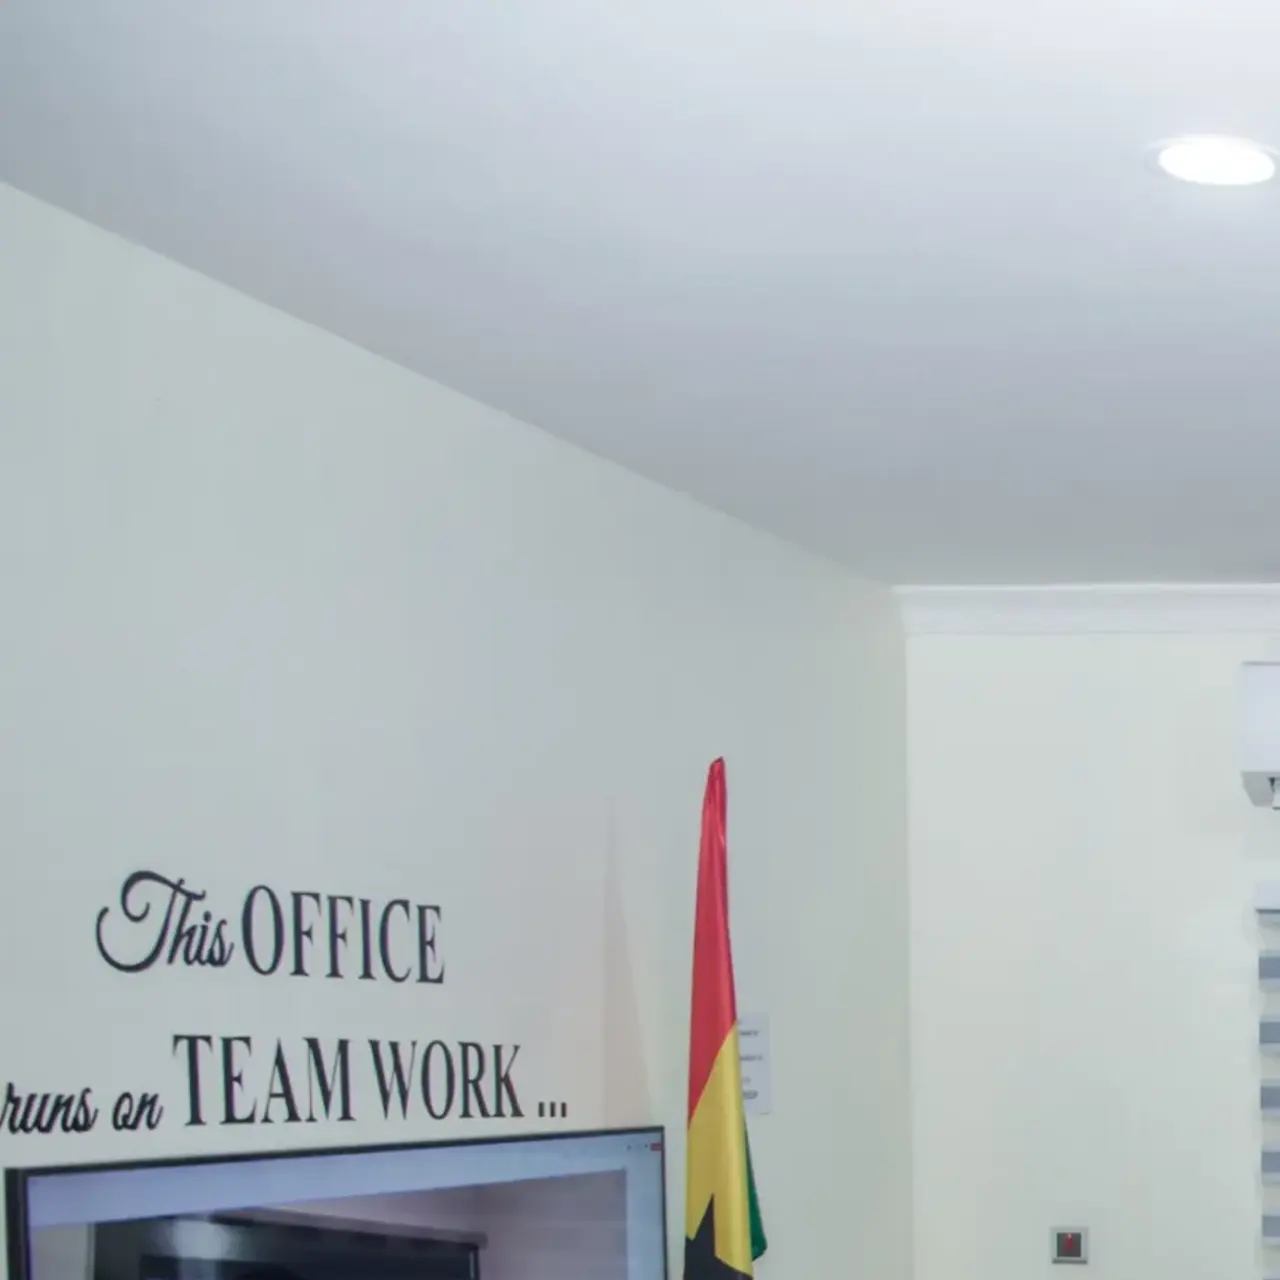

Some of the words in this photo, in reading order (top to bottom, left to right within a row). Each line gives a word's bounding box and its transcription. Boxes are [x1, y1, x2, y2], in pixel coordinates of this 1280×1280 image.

[96, 871, 233, 972] This
[242, 885, 443, 983] OFFICE
[0, 1083, 98, 1134] runs
[113, 1092, 162, 1130] on
